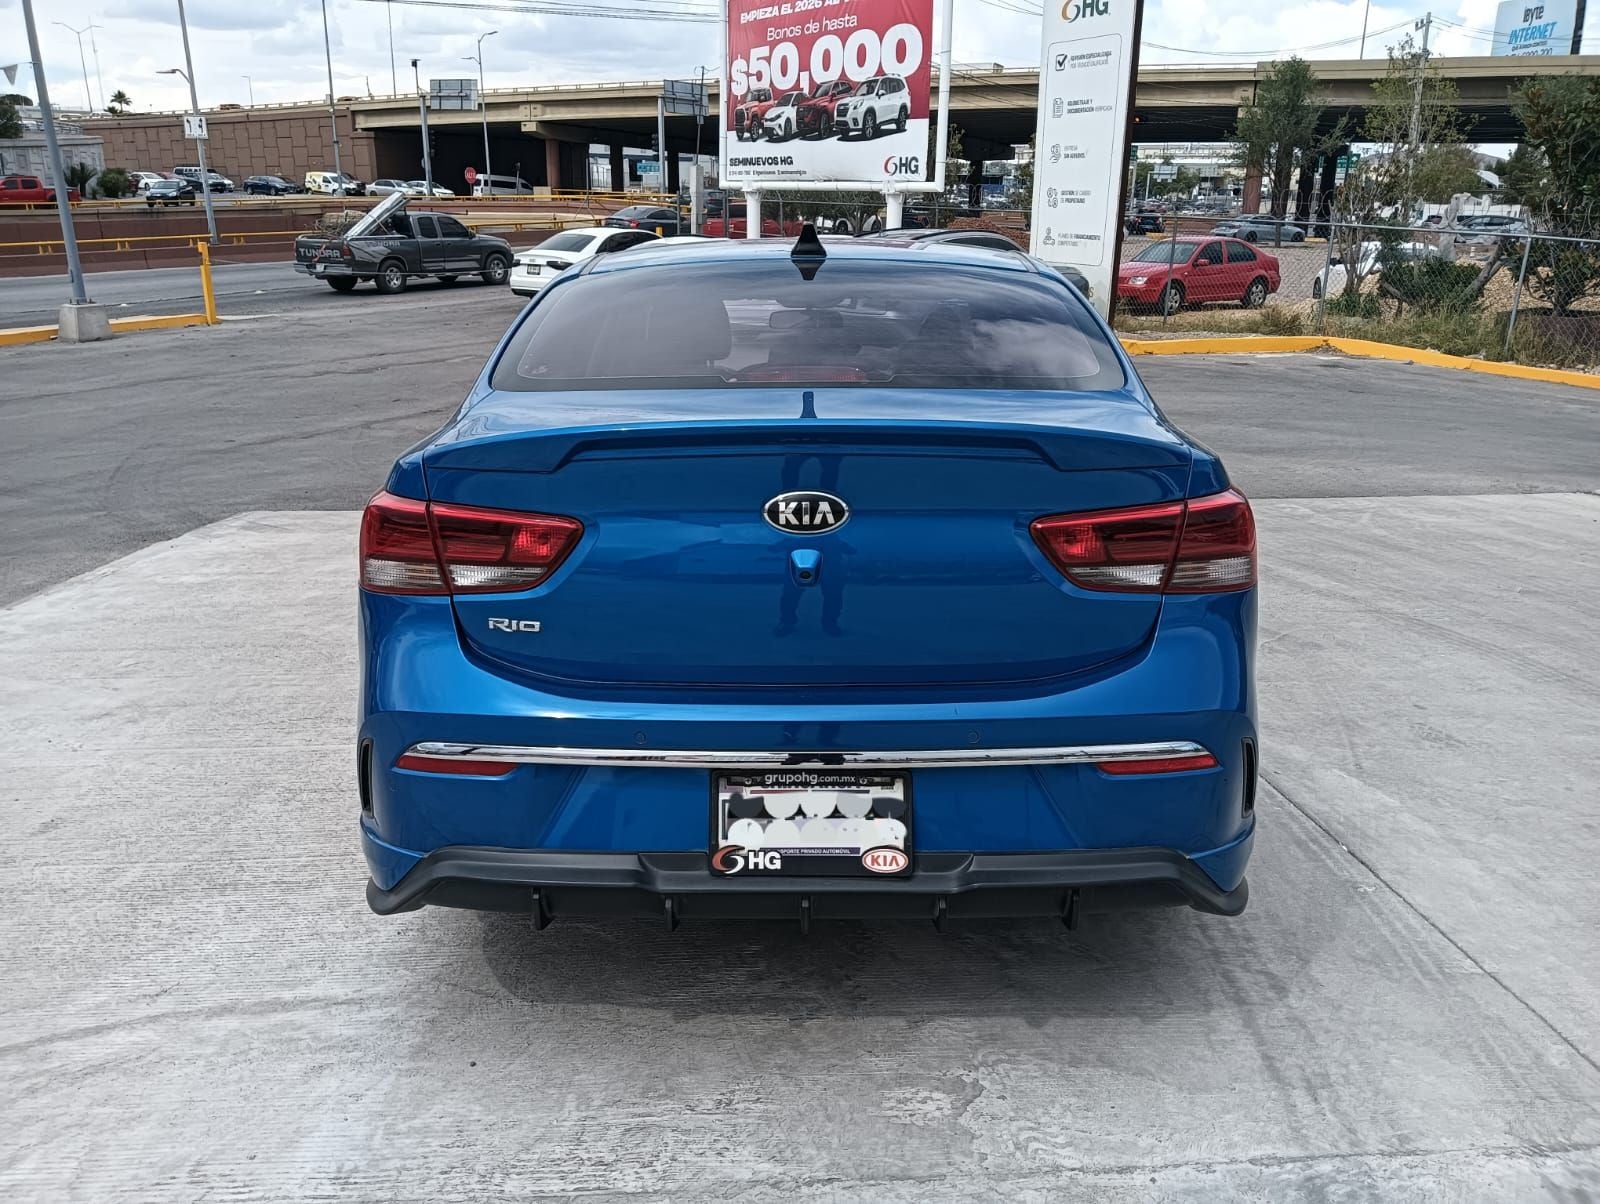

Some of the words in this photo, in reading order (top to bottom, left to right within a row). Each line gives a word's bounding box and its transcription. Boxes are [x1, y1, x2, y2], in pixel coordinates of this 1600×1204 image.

[740, 6, 779, 24] EMPIEZA
[781, 3, 793, 14] EL
[794, 0, 822, 13] 2026
[1082, 0, 1109, 18] HG
[767, 27, 802, 41] Bonos
[804, 20, 820, 35] de
[822, 14, 858, 33] hasta
[1508, 22, 1558, 45] INTERNET
[731, 23, 923, 99] $50,000
[729, 156, 779, 167] SEMINUEVOS
[780, 156, 794, 166] HG
[899, 156, 919, 175] HG
[299, 247, 341, 258] TUNDRA
[777, 501, 836, 526] KIA
[488, 617, 540, 632] RIO
[765, 771, 856, 785] grupohg.com.mx
[748, 851, 781, 870] HG
[870, 854, 900, 867] KIA
